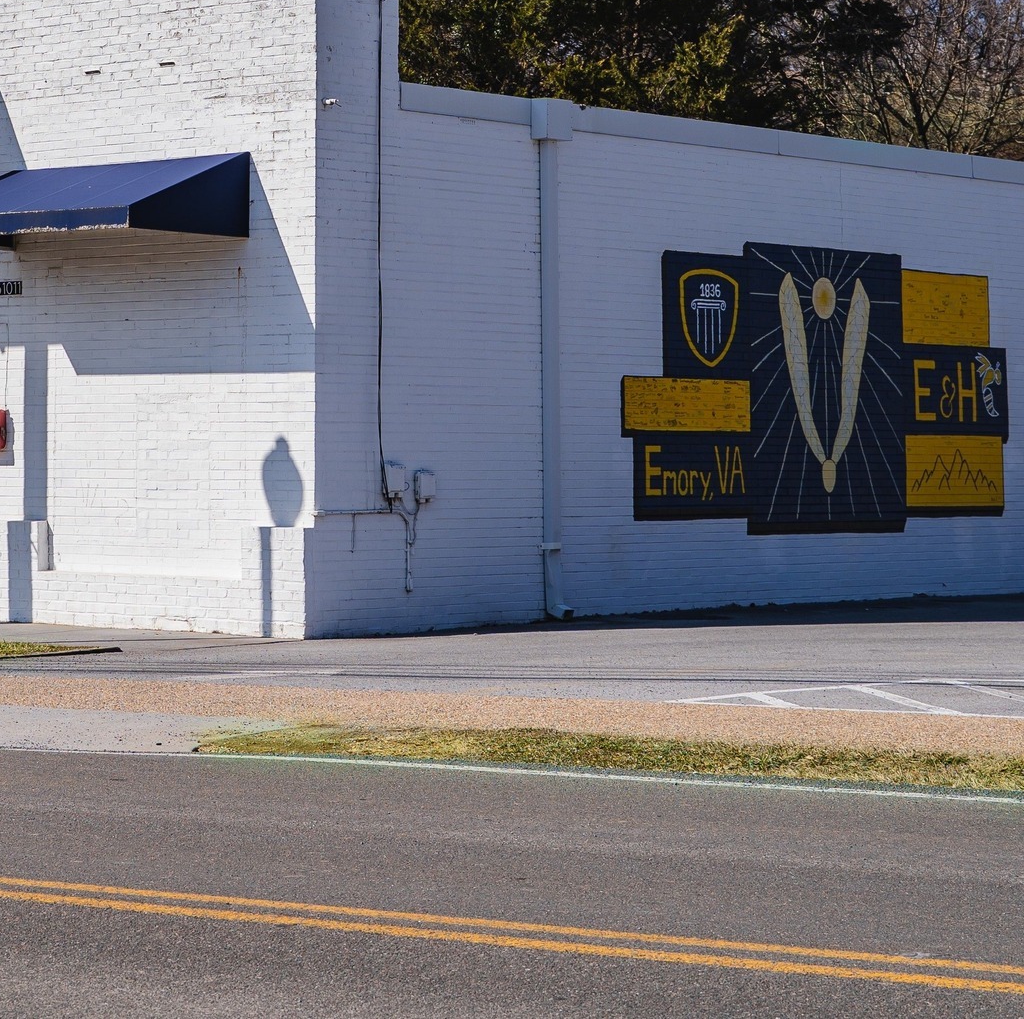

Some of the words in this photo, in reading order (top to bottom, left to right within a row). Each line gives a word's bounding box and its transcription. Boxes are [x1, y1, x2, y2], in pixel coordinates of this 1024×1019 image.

[699, 283, 722, 298] 1836
[644, 445, 714, 502] Emory,
[714, 445, 746, 494] VA
